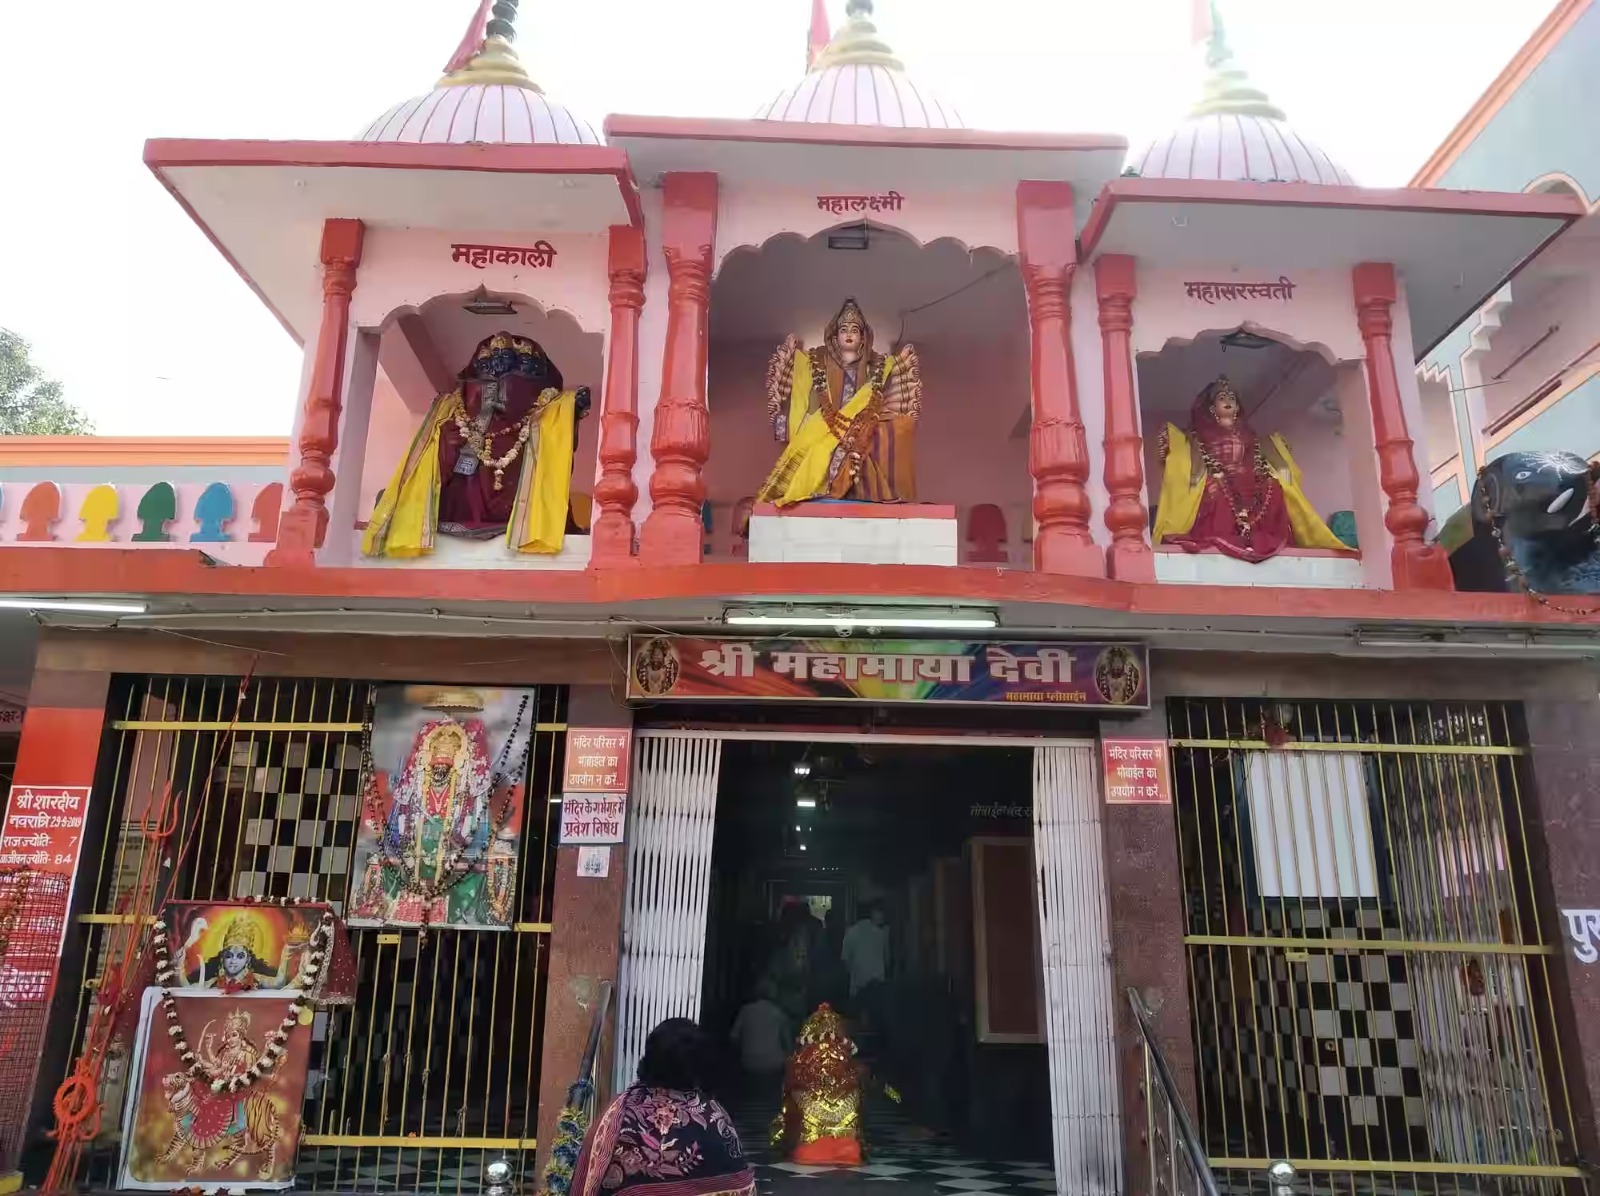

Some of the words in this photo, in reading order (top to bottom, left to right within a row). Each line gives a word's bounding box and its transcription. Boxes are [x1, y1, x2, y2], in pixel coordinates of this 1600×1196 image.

[816, 190, 905, 215] महालक्ष्मी
[450, 240, 557, 269] महाकाली
[1183, 276, 1297, 305] महासरस्वती
[698, 643, 760, 677] श्री
[770, 652, 976, 683] महामाया
[986, 647, 1077, 683] देवी
[607, 756, 619, 768] का
[1109, 746, 1128, 760] मंदिर
[1129, 746, 1153, 760] परिसर
[1146, 767, 1157, 779] का
[16, 789, 34, 809] श्री
[33, 791, 81, 813] शारदीय
[564, 799, 584, 816] मंदिर
[585, 798, 593, 815] के
[9, 811, 51, 829] नवरात्रि
[563, 818, 591, 838] प्रवेश
[592, 817, 620, 838] निषेध
[68, 836, 78, 848] 7
[54, 853, 73, 866] 84
